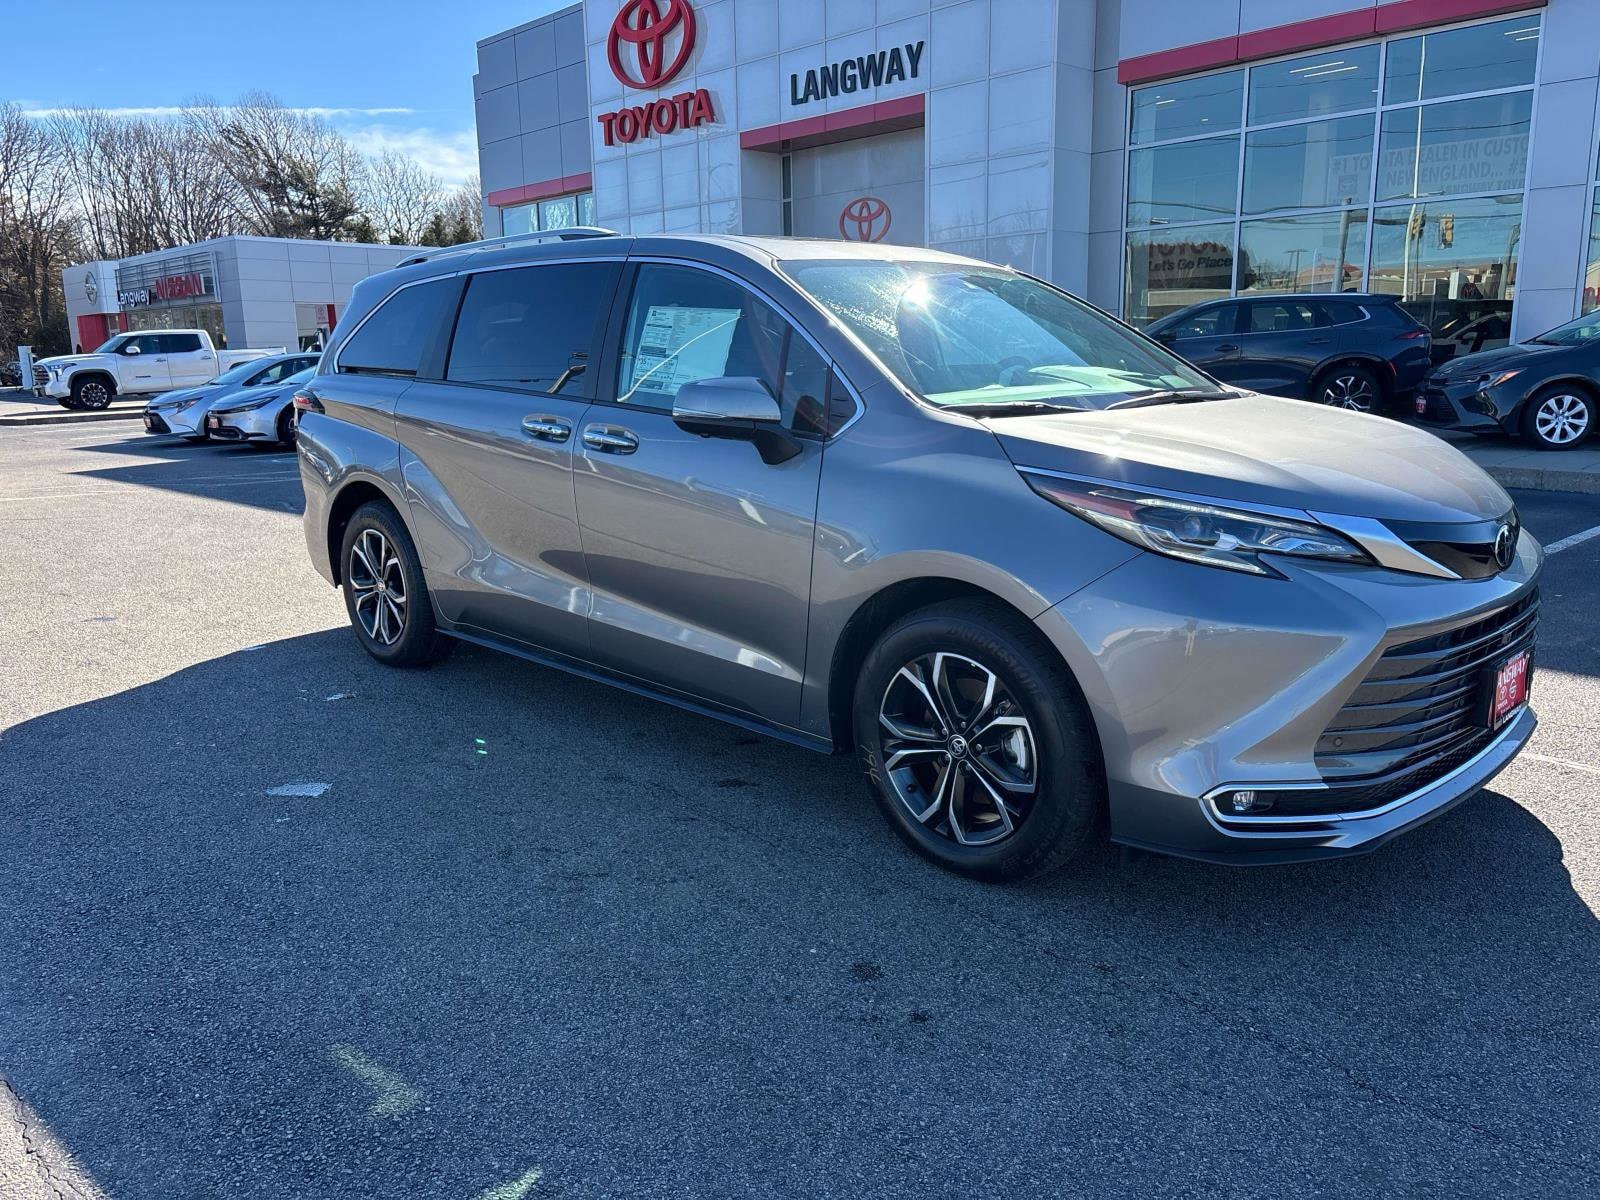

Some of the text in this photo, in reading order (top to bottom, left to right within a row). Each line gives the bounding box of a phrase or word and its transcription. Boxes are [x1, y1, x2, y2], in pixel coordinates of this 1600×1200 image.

[790, 41, 925, 105] LANGWAY
[598, 88, 716, 146] TOYOTA
[1463, 142, 1479, 159] IN
[1178, 258, 1195, 269] Go
[117, 272, 206, 308] Langway NISSAN
